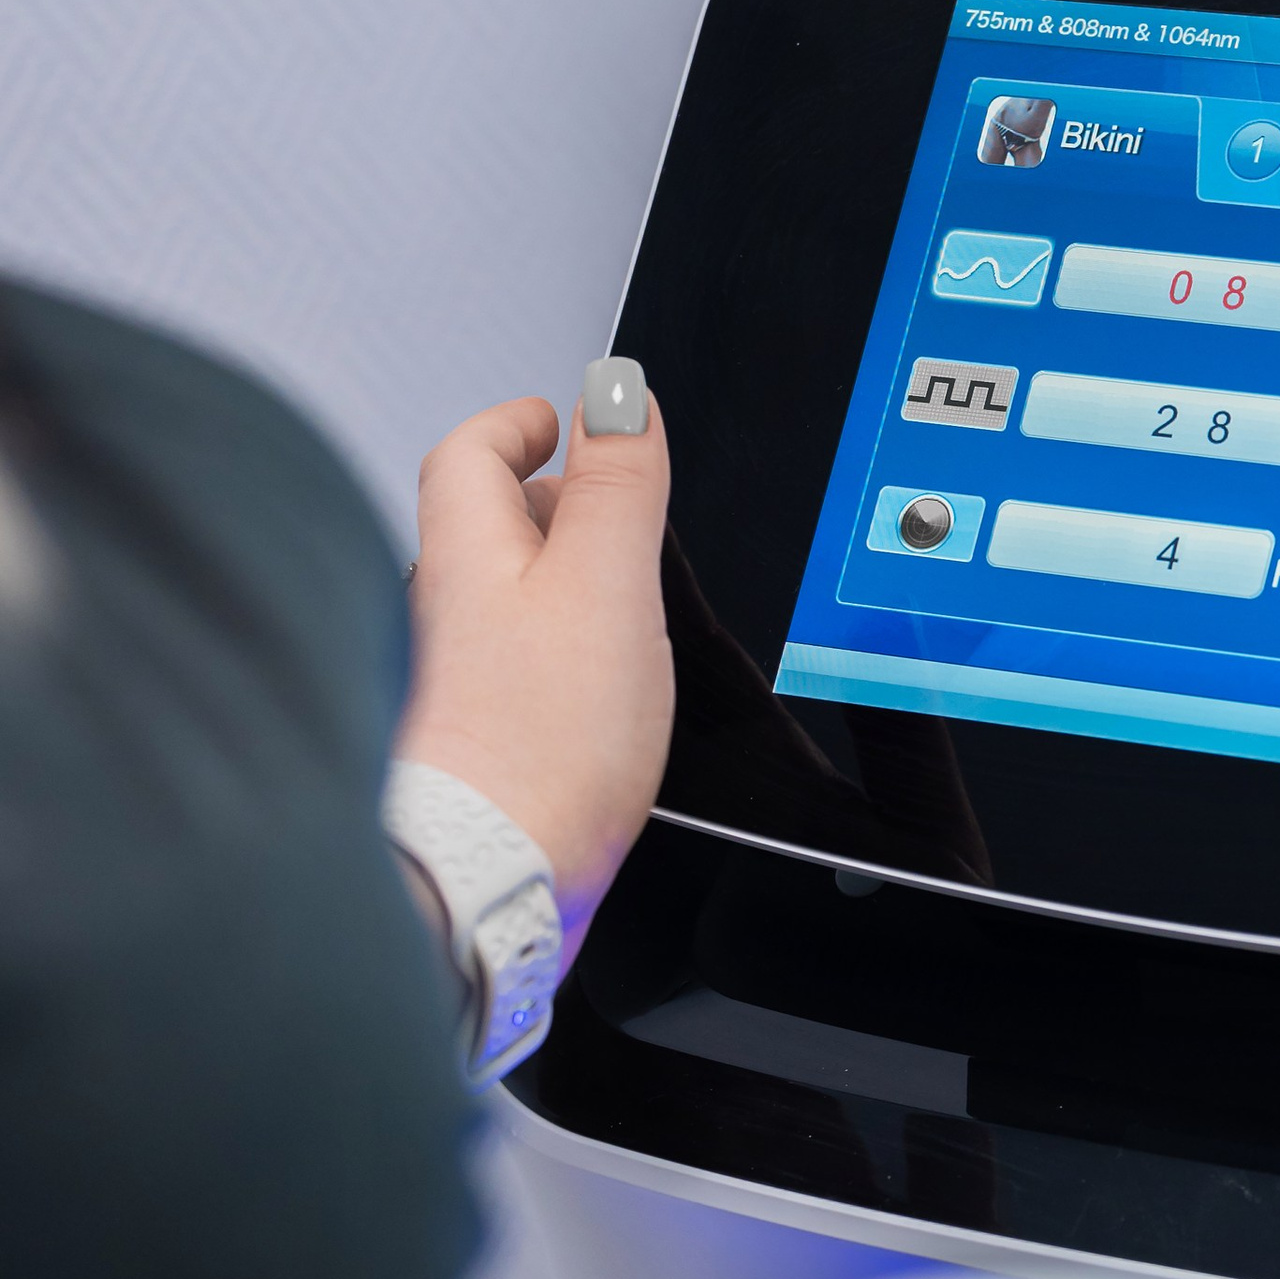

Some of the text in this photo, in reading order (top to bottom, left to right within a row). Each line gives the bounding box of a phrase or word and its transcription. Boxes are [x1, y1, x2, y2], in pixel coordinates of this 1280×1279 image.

[964, 8, 1240, 49] 755nm & 808nm & 1064nm
[1060, 120, 1144, 154] Bikini
[1250, 136, 1263, 163] 1
[1156, 537, 1180, 570] 4
